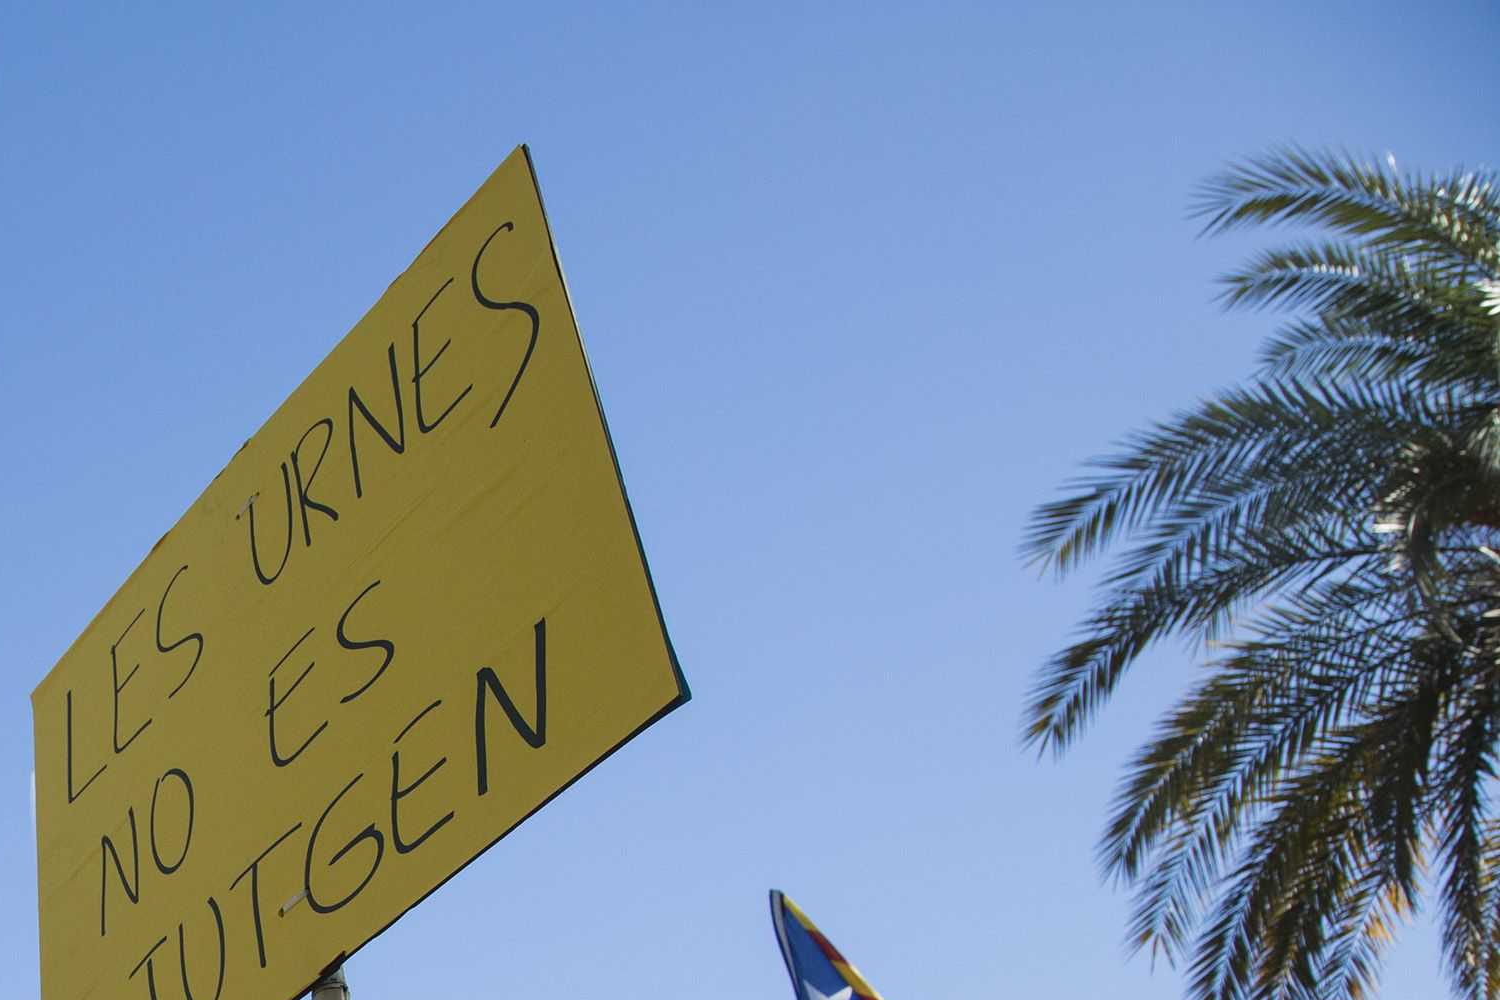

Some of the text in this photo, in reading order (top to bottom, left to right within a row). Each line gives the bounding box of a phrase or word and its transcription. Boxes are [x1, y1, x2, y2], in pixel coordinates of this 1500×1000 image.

[67, 221, 540, 804] LES URNES
[101, 579, 395, 937] NO ES
